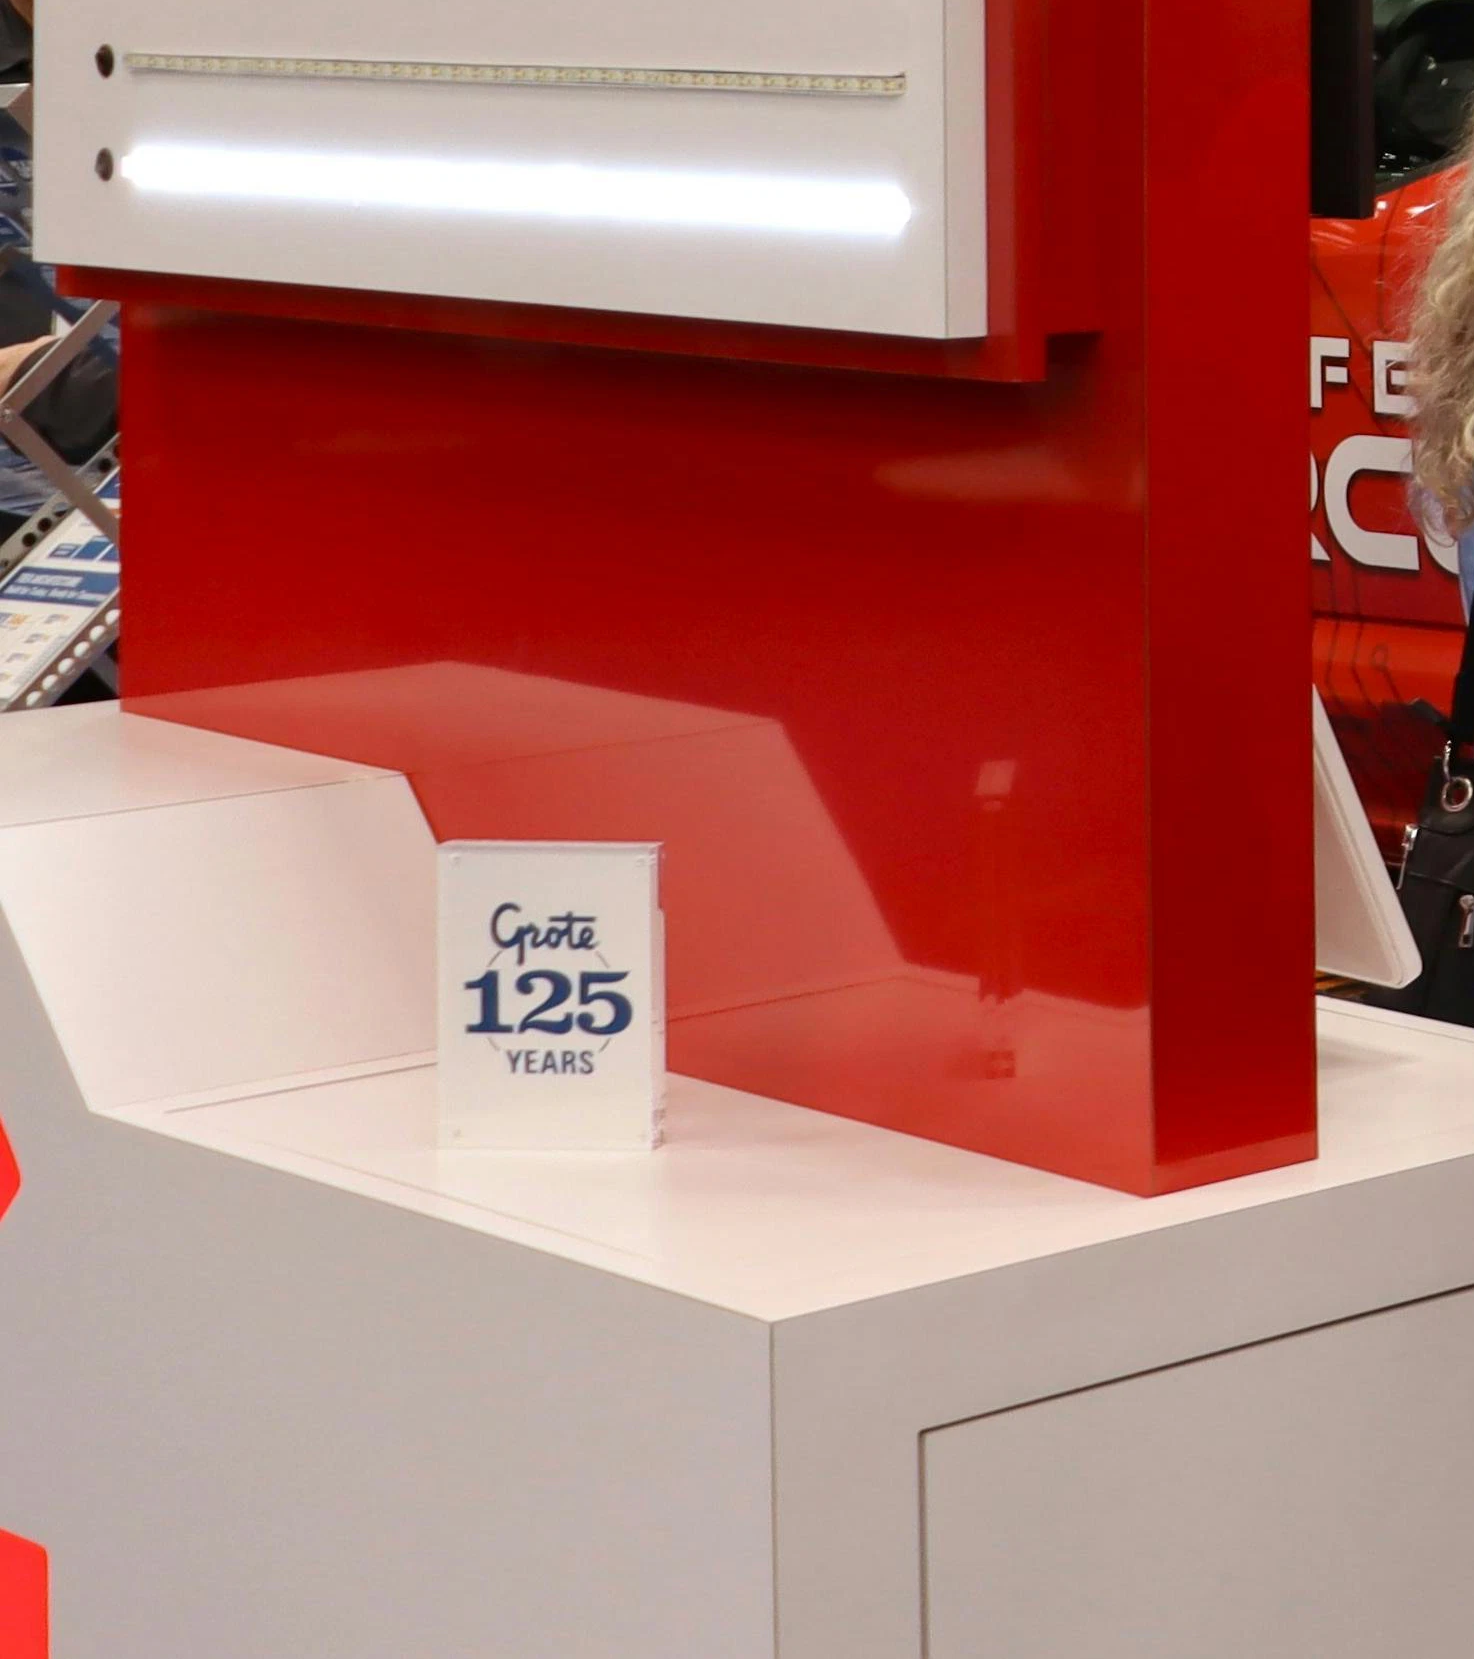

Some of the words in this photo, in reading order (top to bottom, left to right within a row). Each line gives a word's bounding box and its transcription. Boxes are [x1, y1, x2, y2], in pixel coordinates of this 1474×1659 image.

[490, 901, 600, 966] Grote
[463, 969, 634, 1036] 125
[506, 1048, 595, 1076] YEARS
